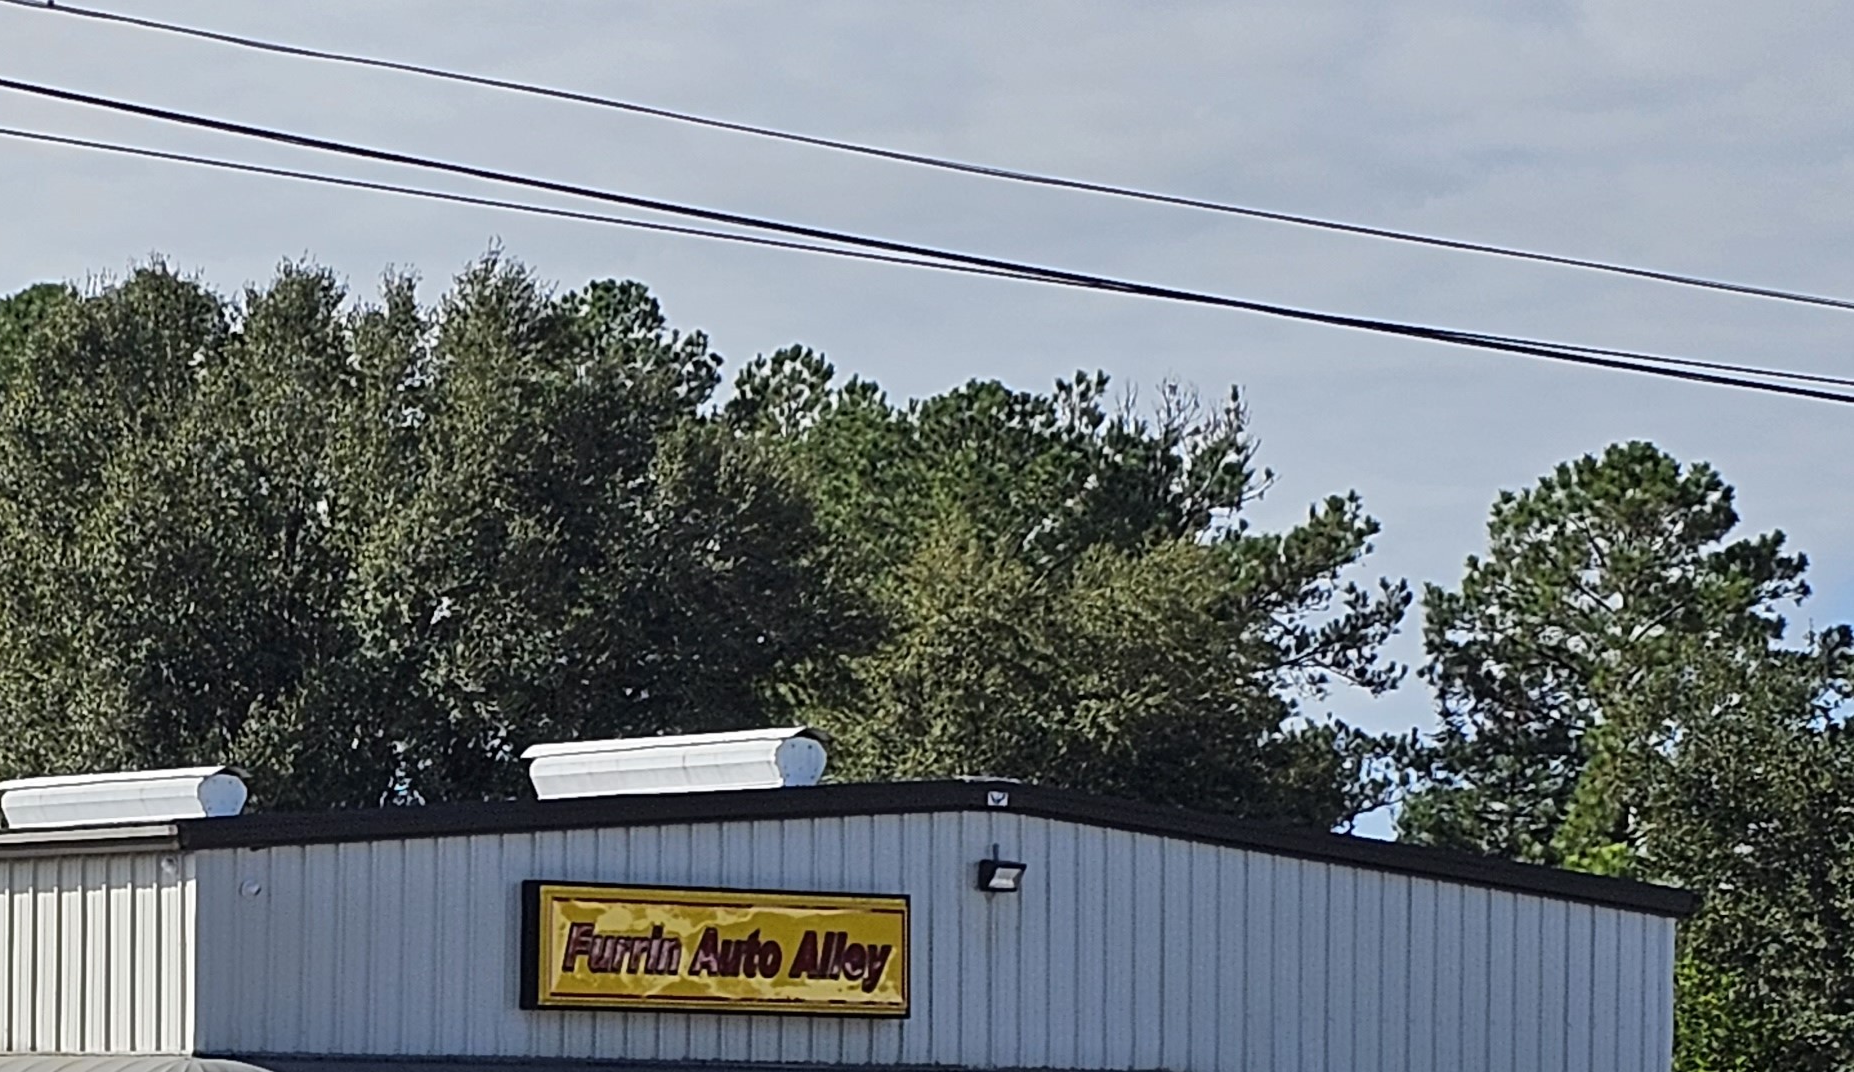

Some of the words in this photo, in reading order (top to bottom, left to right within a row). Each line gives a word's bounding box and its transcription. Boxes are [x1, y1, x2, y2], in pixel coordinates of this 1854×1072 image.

[562, 921, 682, 976] Furrin
[689, 926, 783, 979] Auto
[788, 930, 893, 993] Alley
